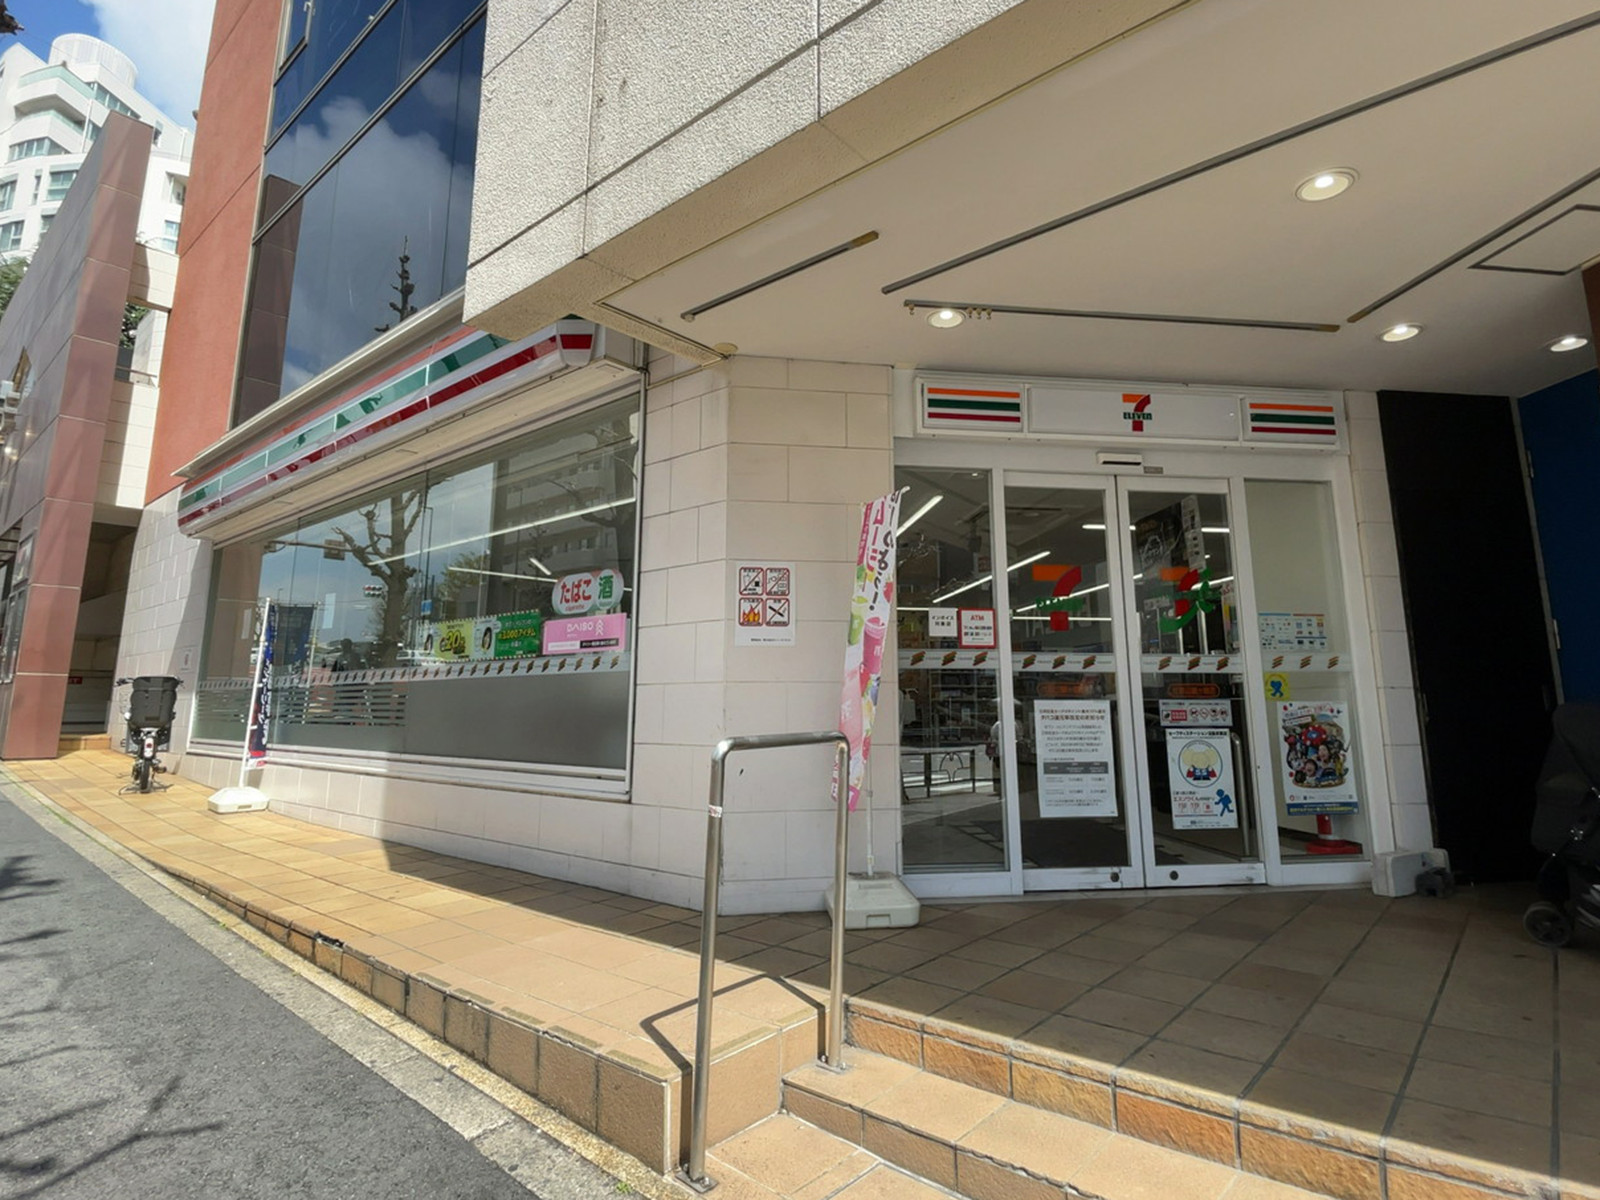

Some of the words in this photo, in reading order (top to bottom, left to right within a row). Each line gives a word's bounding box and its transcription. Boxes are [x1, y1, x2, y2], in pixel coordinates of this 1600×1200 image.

[1121, 393, 1151, 432] 7
[559, 578, 592, 604] たばこ
[598, 574, 614, 600] 酒
